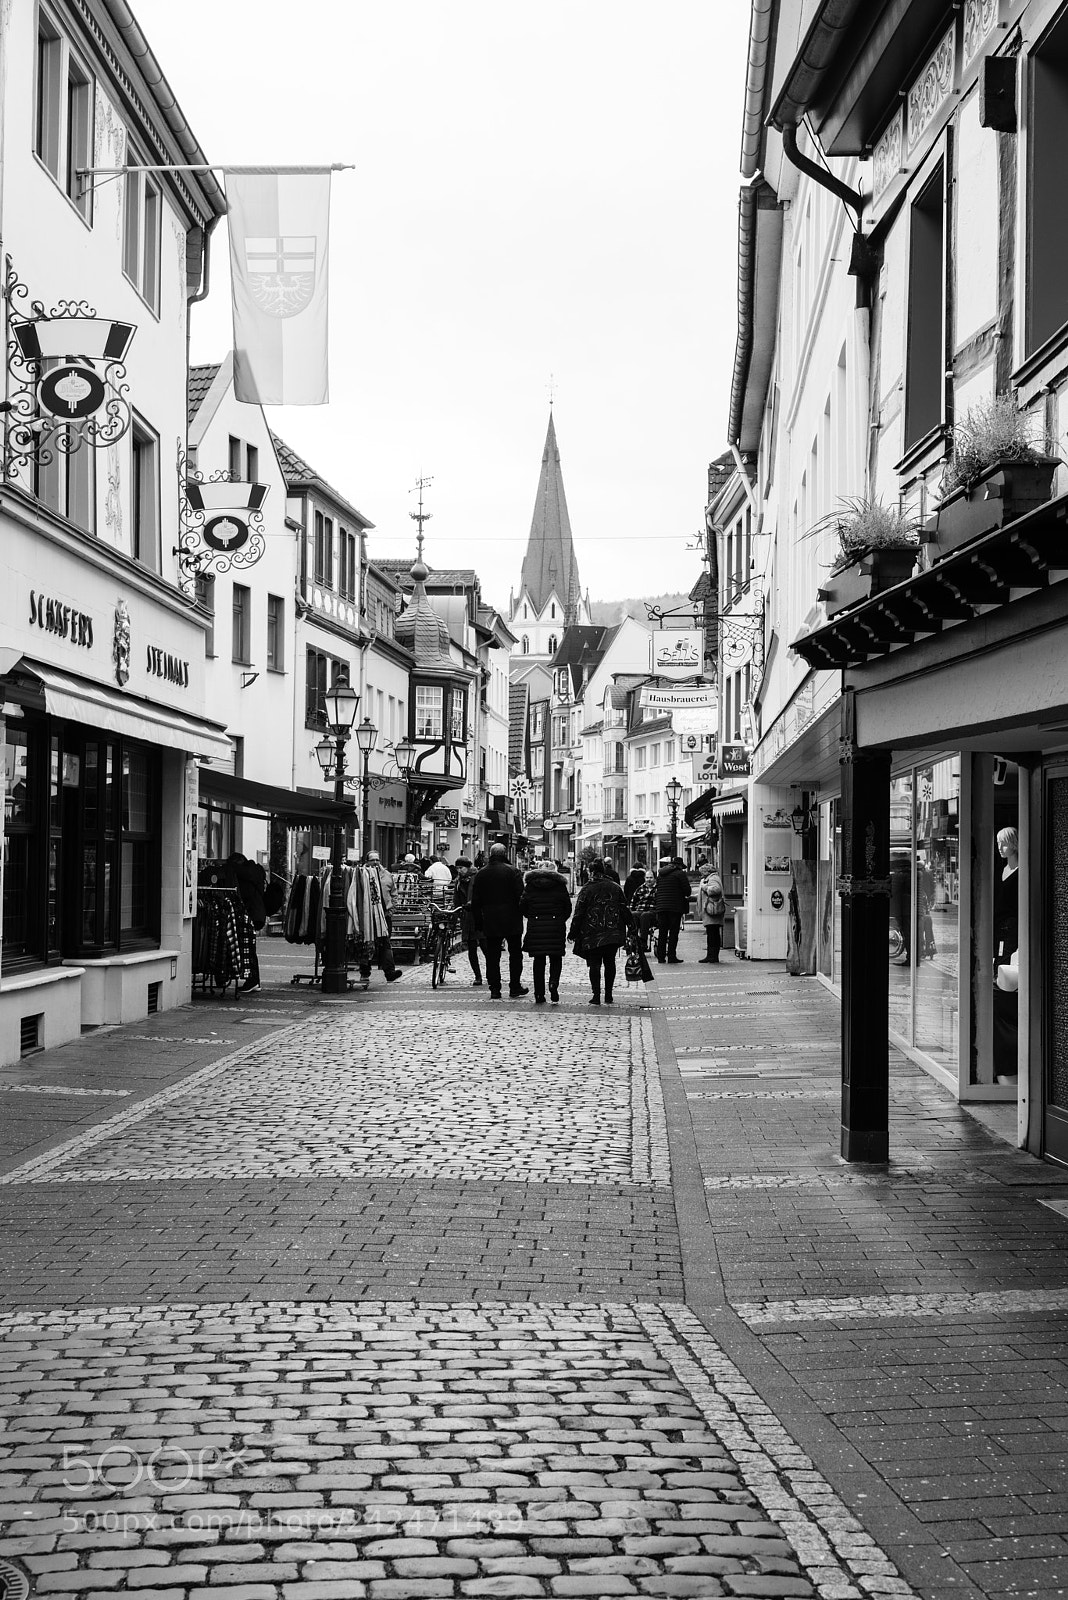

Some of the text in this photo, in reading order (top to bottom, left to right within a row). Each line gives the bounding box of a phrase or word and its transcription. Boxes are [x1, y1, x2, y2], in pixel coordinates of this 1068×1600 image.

[649, 694, 708, 703] Hausbrauerei
[723, 762, 749, 772] West
[697, 772, 724, 780] LOTT
